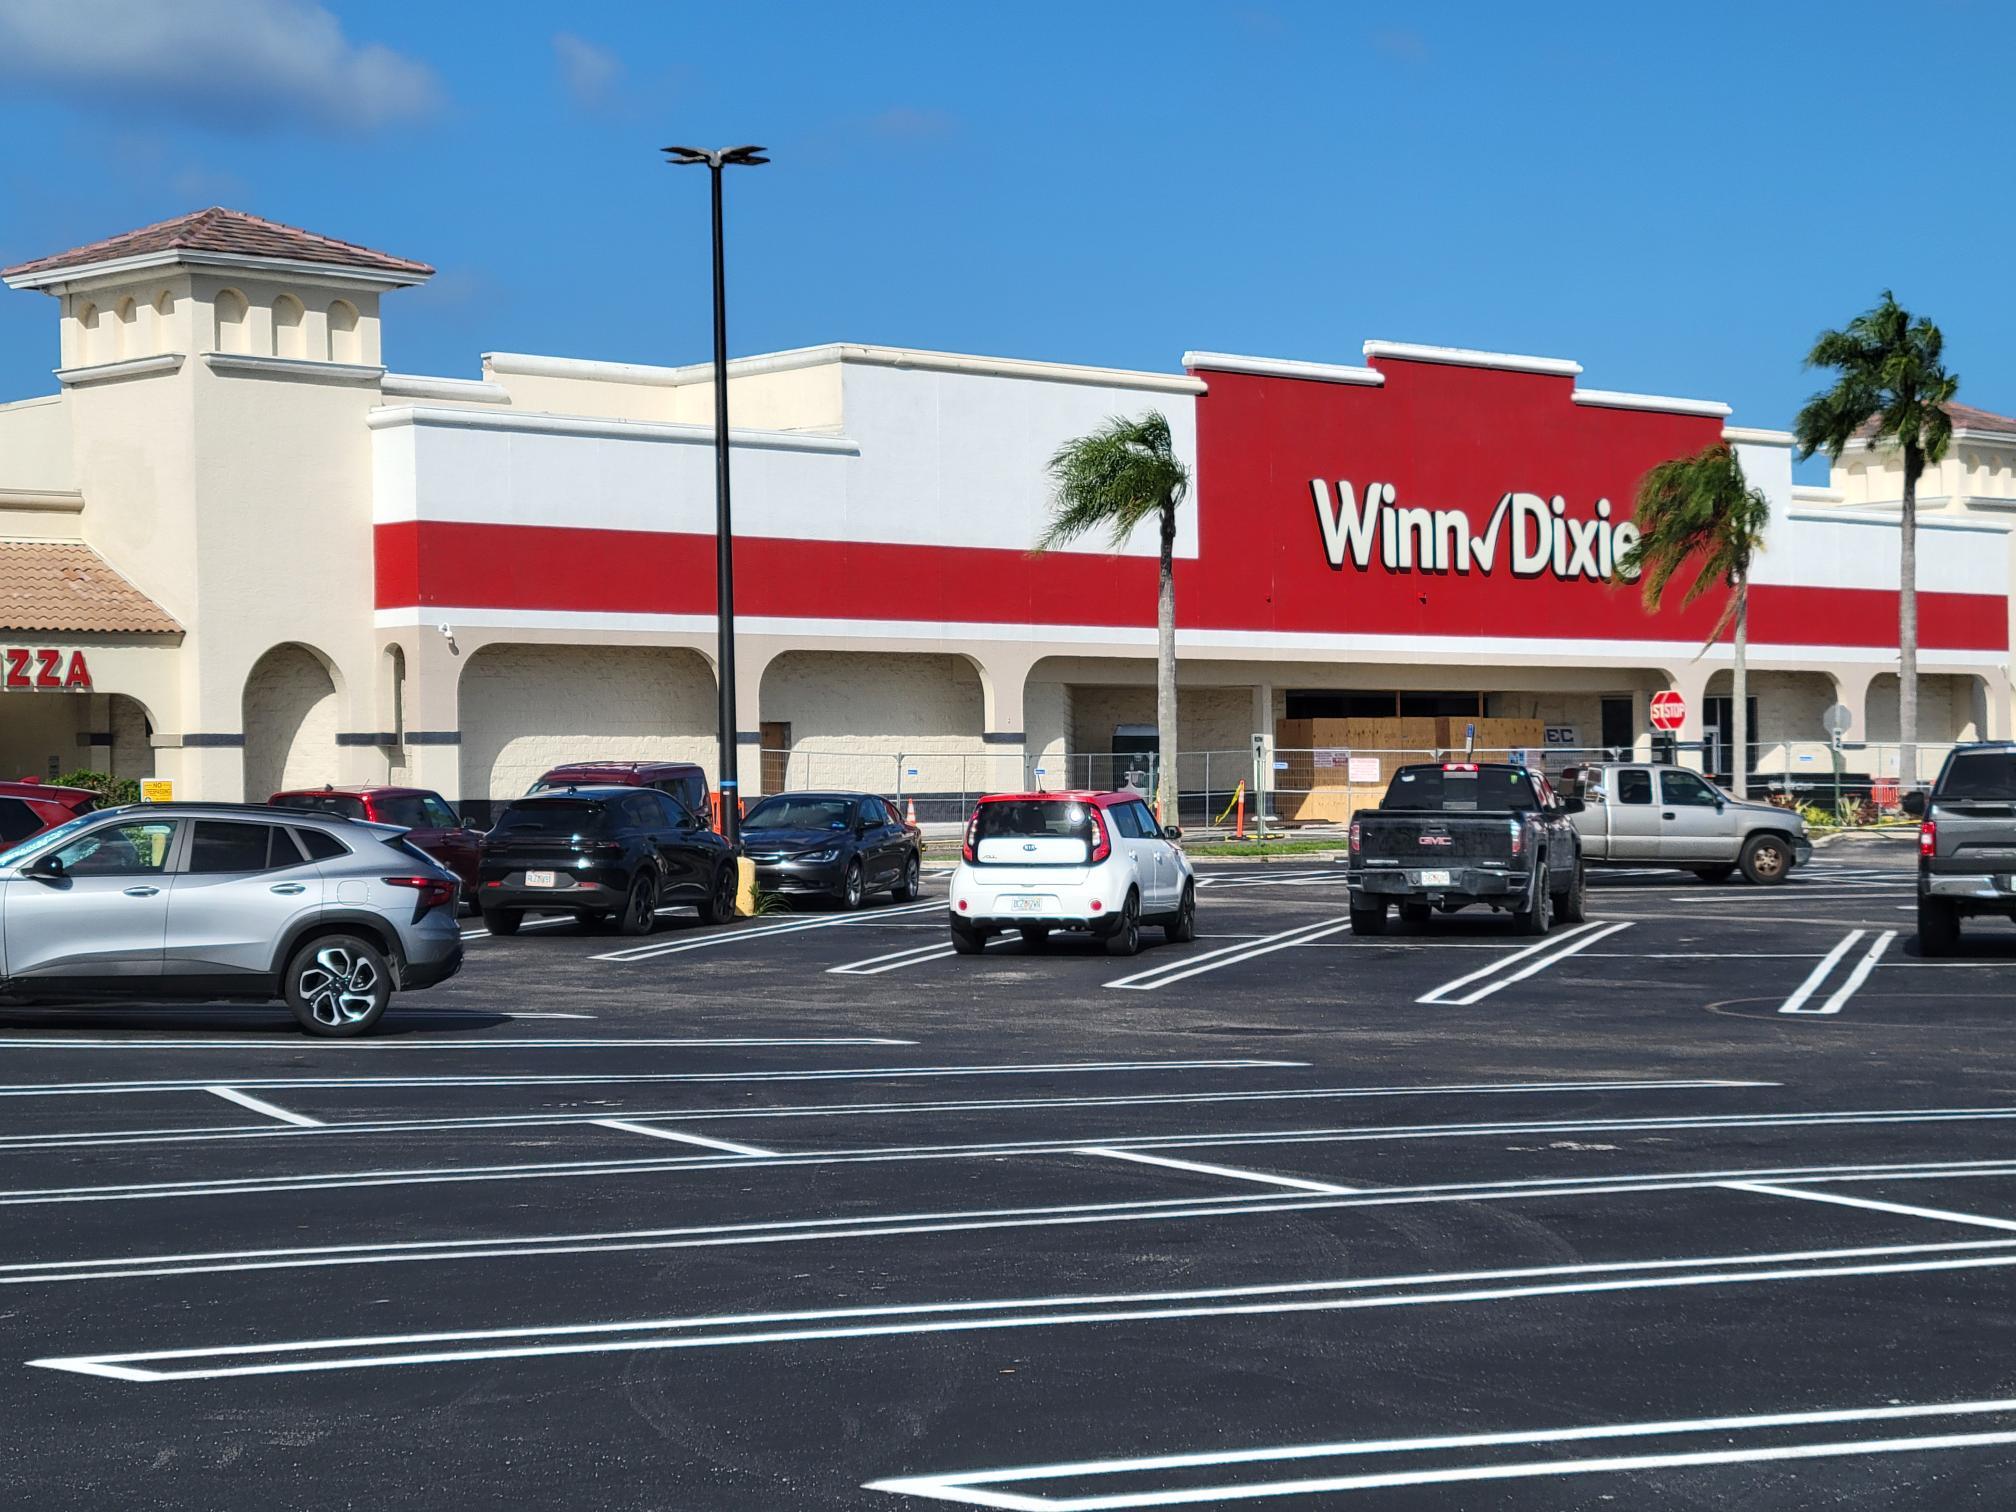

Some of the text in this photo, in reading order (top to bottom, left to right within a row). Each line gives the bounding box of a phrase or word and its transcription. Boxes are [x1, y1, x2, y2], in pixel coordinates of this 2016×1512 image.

[1310, 478, 1643, 584] Winn Dixie
[0, 648, 92, 687] ZZA
[1664, 703, 1685, 718] STOP
[1543, 728, 1574, 743] EC
[1255, 745, 1262, 758] 1
[1023, 844, 1037, 852] KIA
[1418, 836, 1452, 846] GMC
